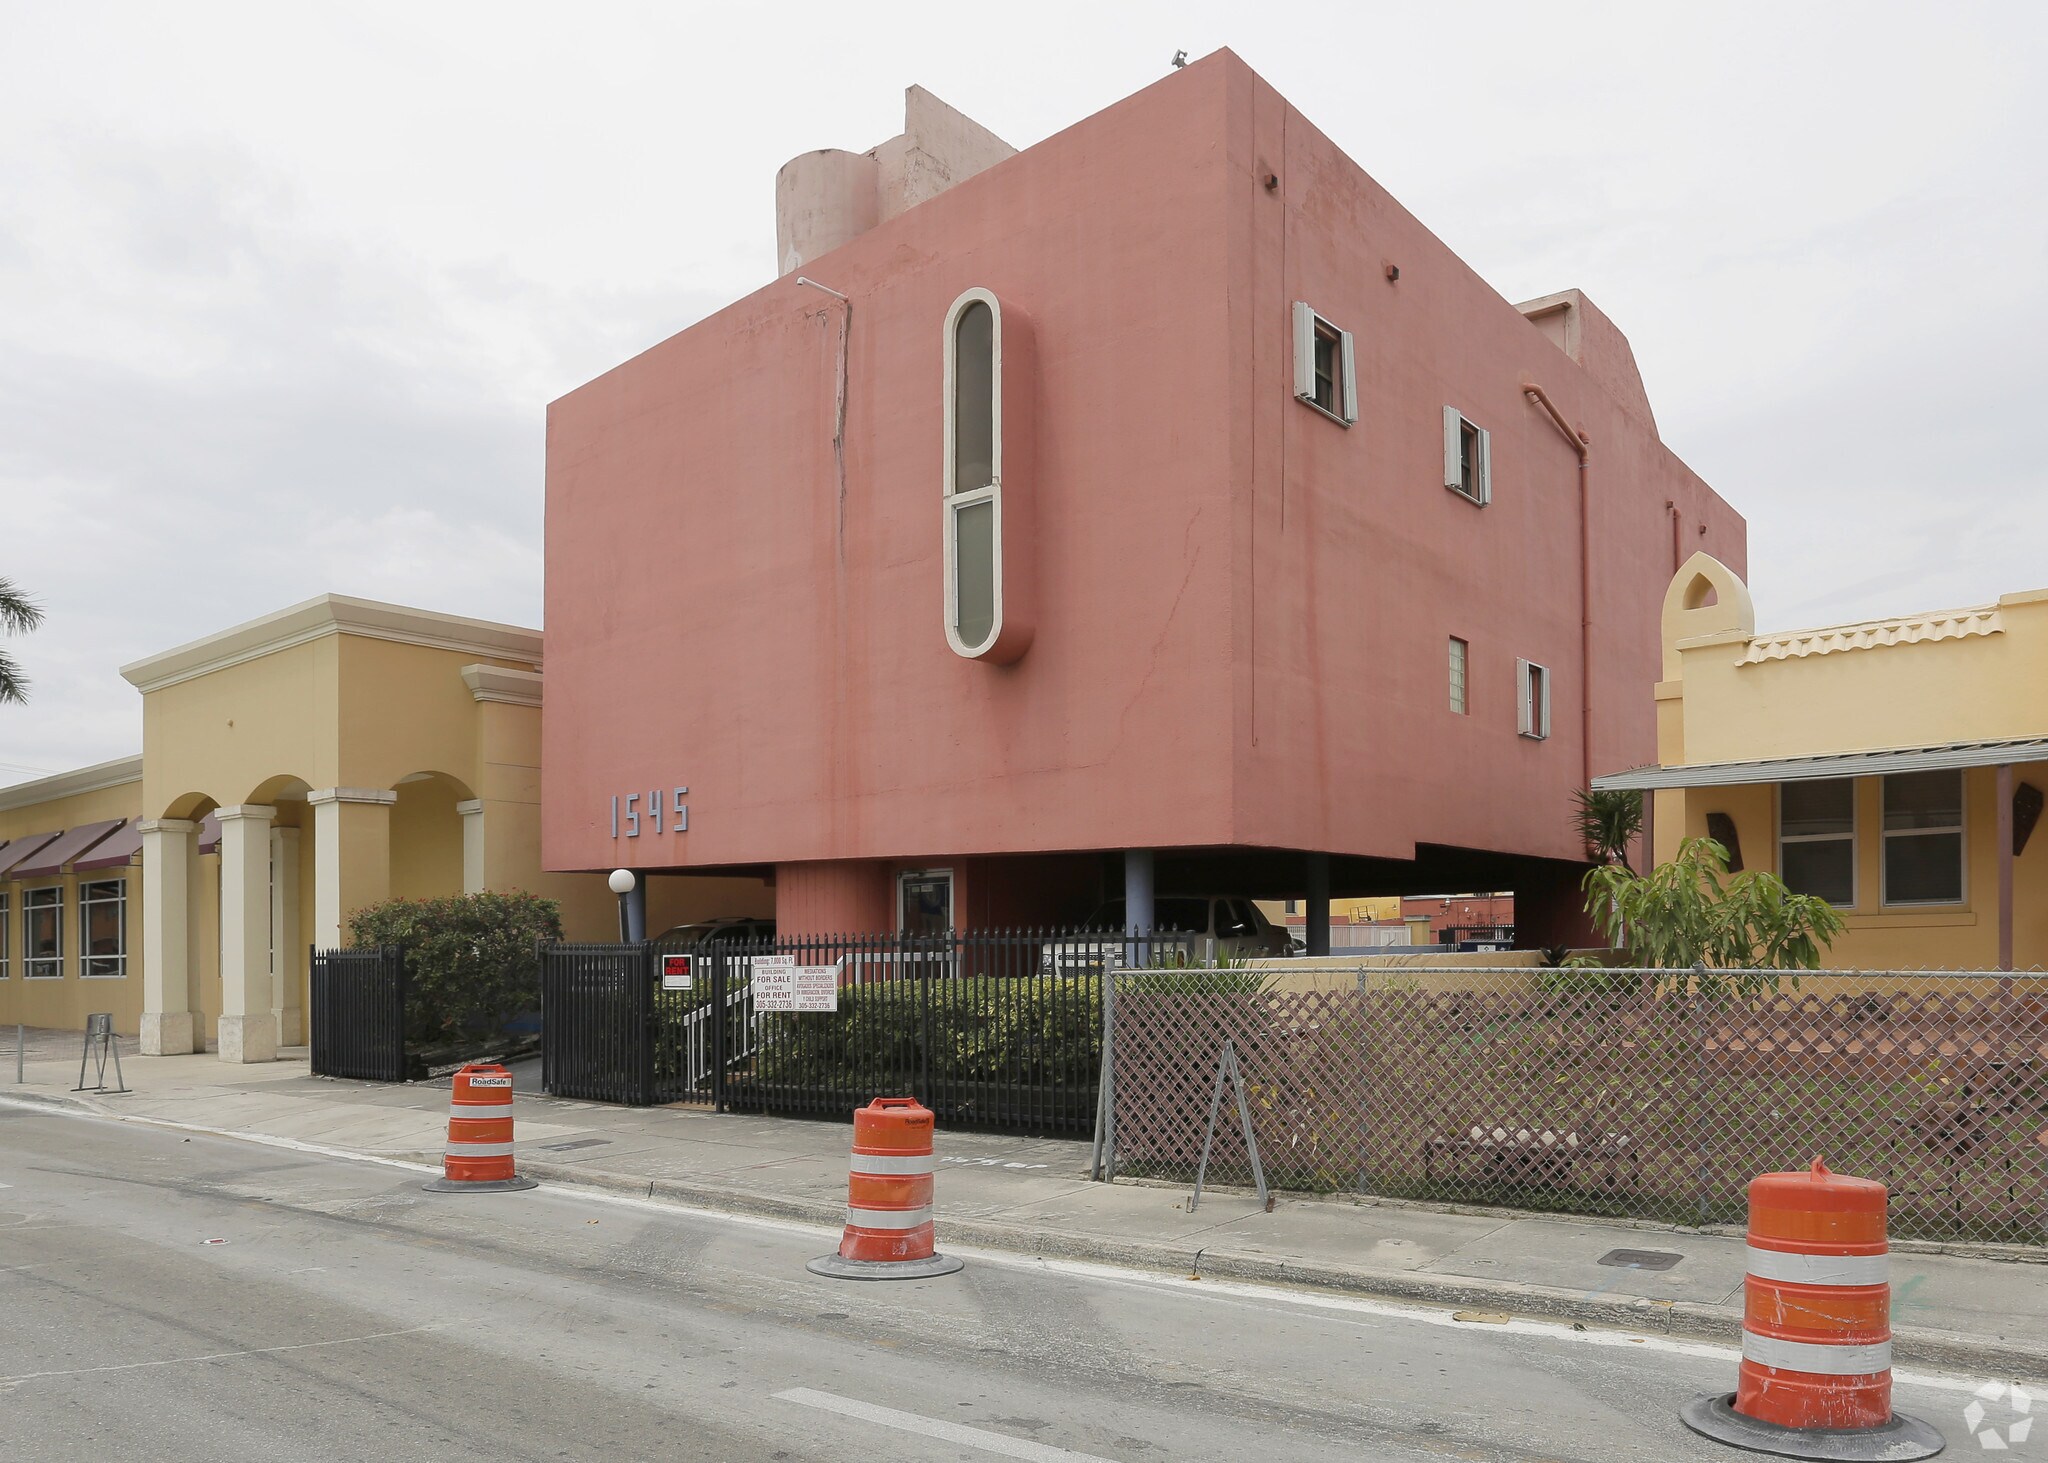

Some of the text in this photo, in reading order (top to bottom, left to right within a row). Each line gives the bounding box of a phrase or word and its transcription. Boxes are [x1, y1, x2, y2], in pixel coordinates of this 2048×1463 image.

[611, 786, 688, 838] 1545
[669, 958, 685, 967] FOR
[665, 966, 689, 975] RENT
[756, 975, 791, 983] FOR SALE
[772, 991, 792, 999] RENT
[755, 1000, 793, 1009] 305-332-2736
[471, 1078, 507, 1086] RoadSafe
